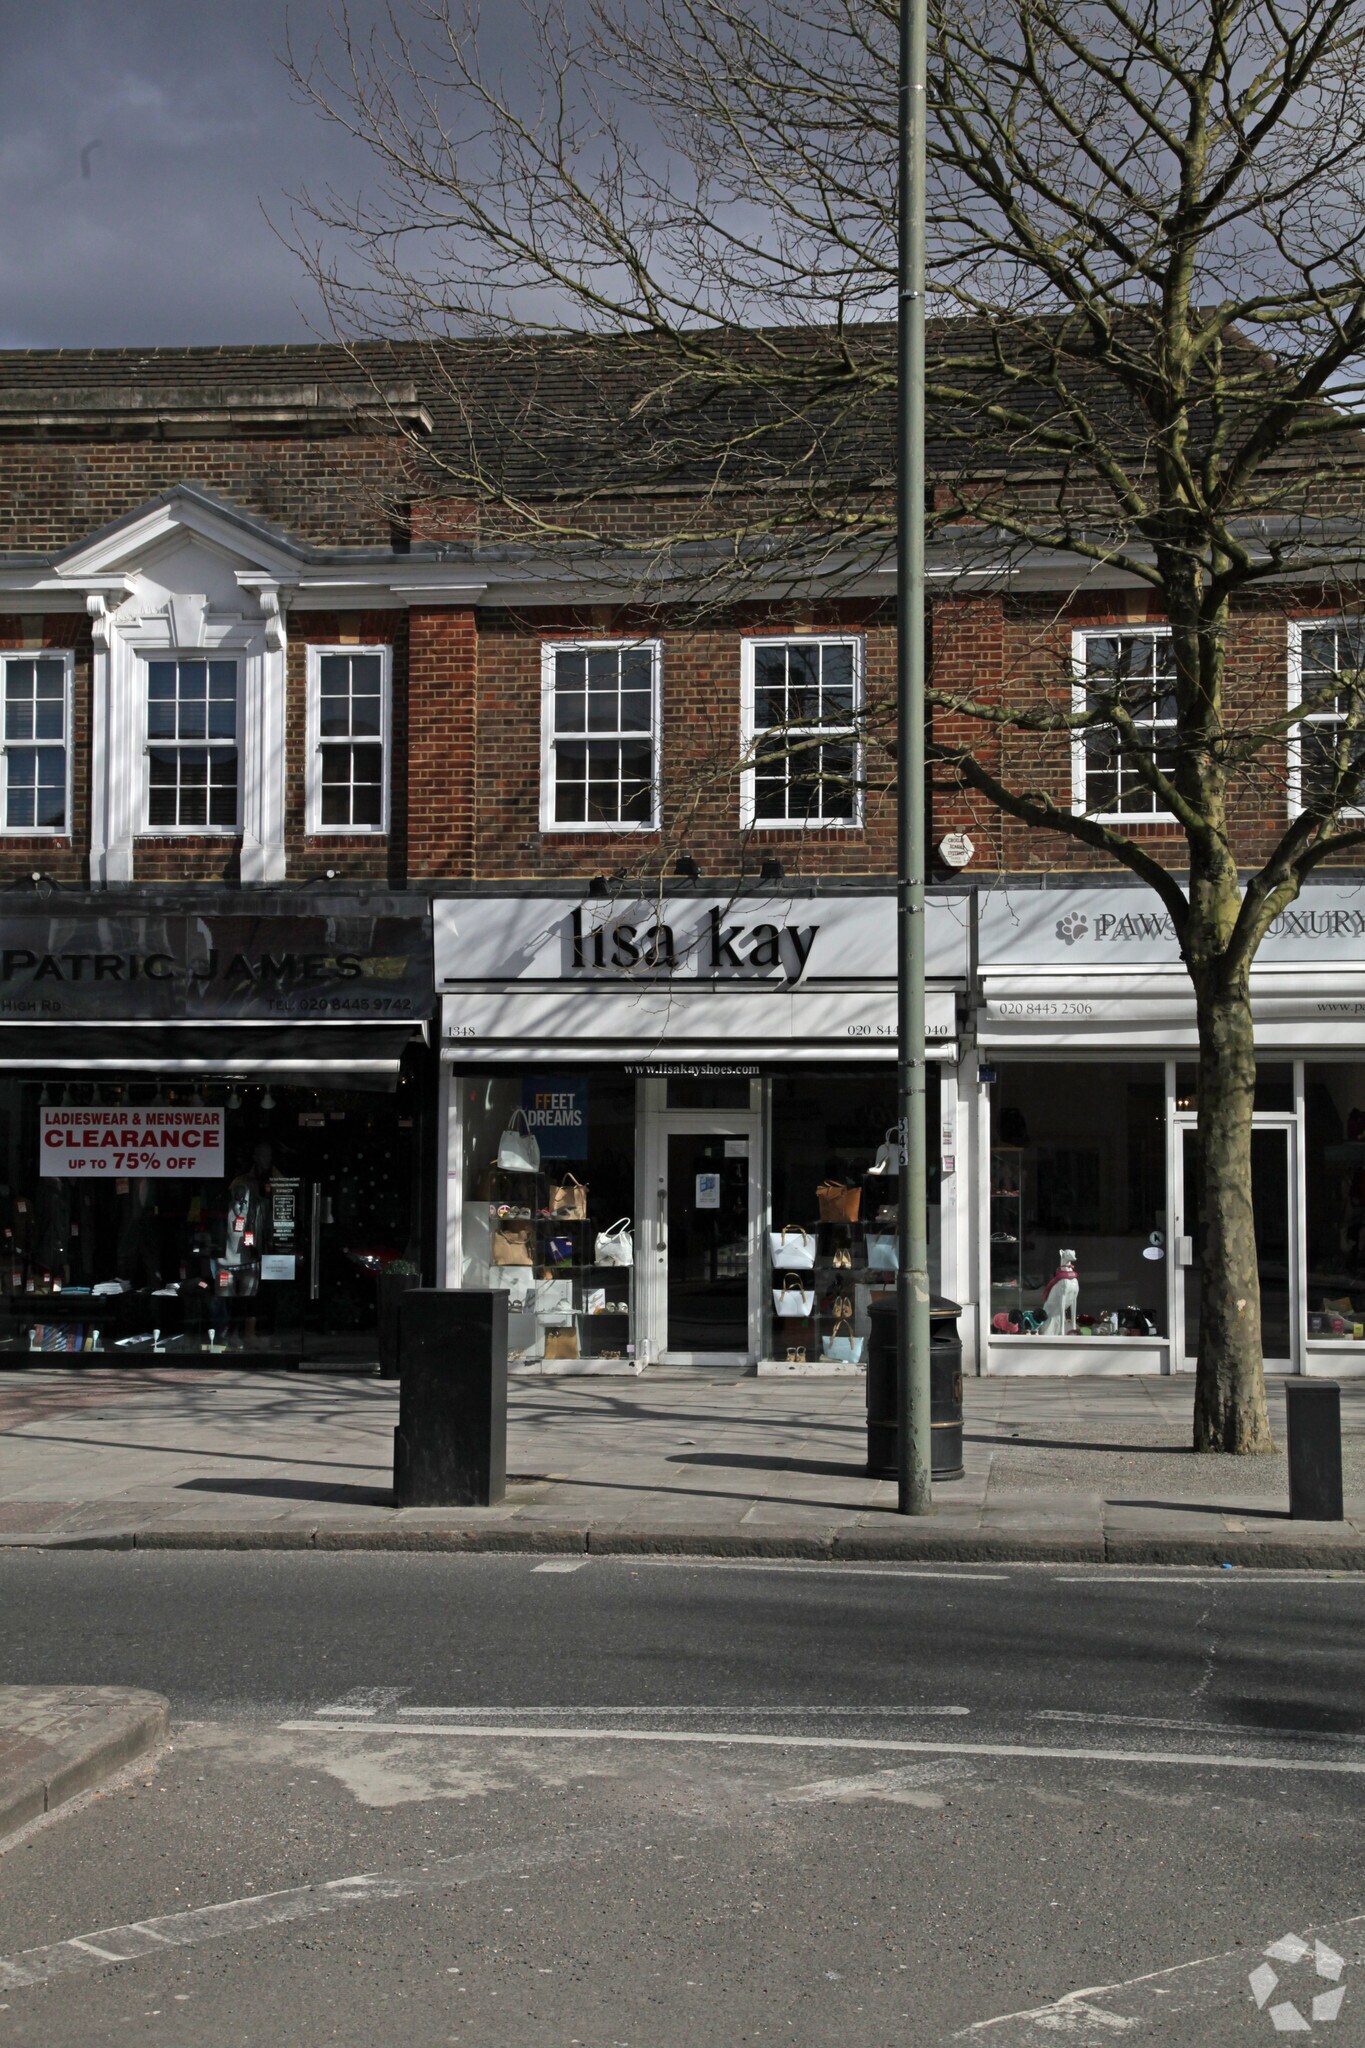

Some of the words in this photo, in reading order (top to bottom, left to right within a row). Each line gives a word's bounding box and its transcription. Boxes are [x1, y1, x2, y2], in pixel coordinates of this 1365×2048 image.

[1268, 910, 1365, 934] UXURY
[571, 907, 679, 968] lisa
[709, 905, 820, 984] kay
[2, 950, 175, 981] PATRIC
[192, 949, 363, 980] JAMES
[2, 1001, 36, 1012] HIGH
[300, 999, 328, 1010] 020
[331, 999, 369, 1010] 8445
[373, 999, 411, 1010] 9742
[1000, 1003, 1023, 1014] 020
[1026, 1003, 1057, 1014] 8445
[1061, 1003, 1092, 1014] 2506
[449, 1026, 475, 1036] 1348
[847, 1025, 871, 1035] 020
[876, 1025, 898, 1035] 844
[924, 1025, 947, 1035] 040
[624, 1063, 760, 1076] www.lisakayshoes.com
[536, 1093, 575, 1109] FFEET
[45, 1113, 128, 1125] LADIESWEAR
[132, 1113, 141, 1125] &
[146, 1113, 220, 1125] MENSWEAR
[528, 1110, 582, 1126] DREAMS
[44, 1130, 220, 1148] CLEARANCE
[68, 1160, 86, 1169] UP
[90, 1159, 107, 1169] TO
[112, 1152, 161, 1169] 75%
[166, 1157, 196, 1169] OFF
